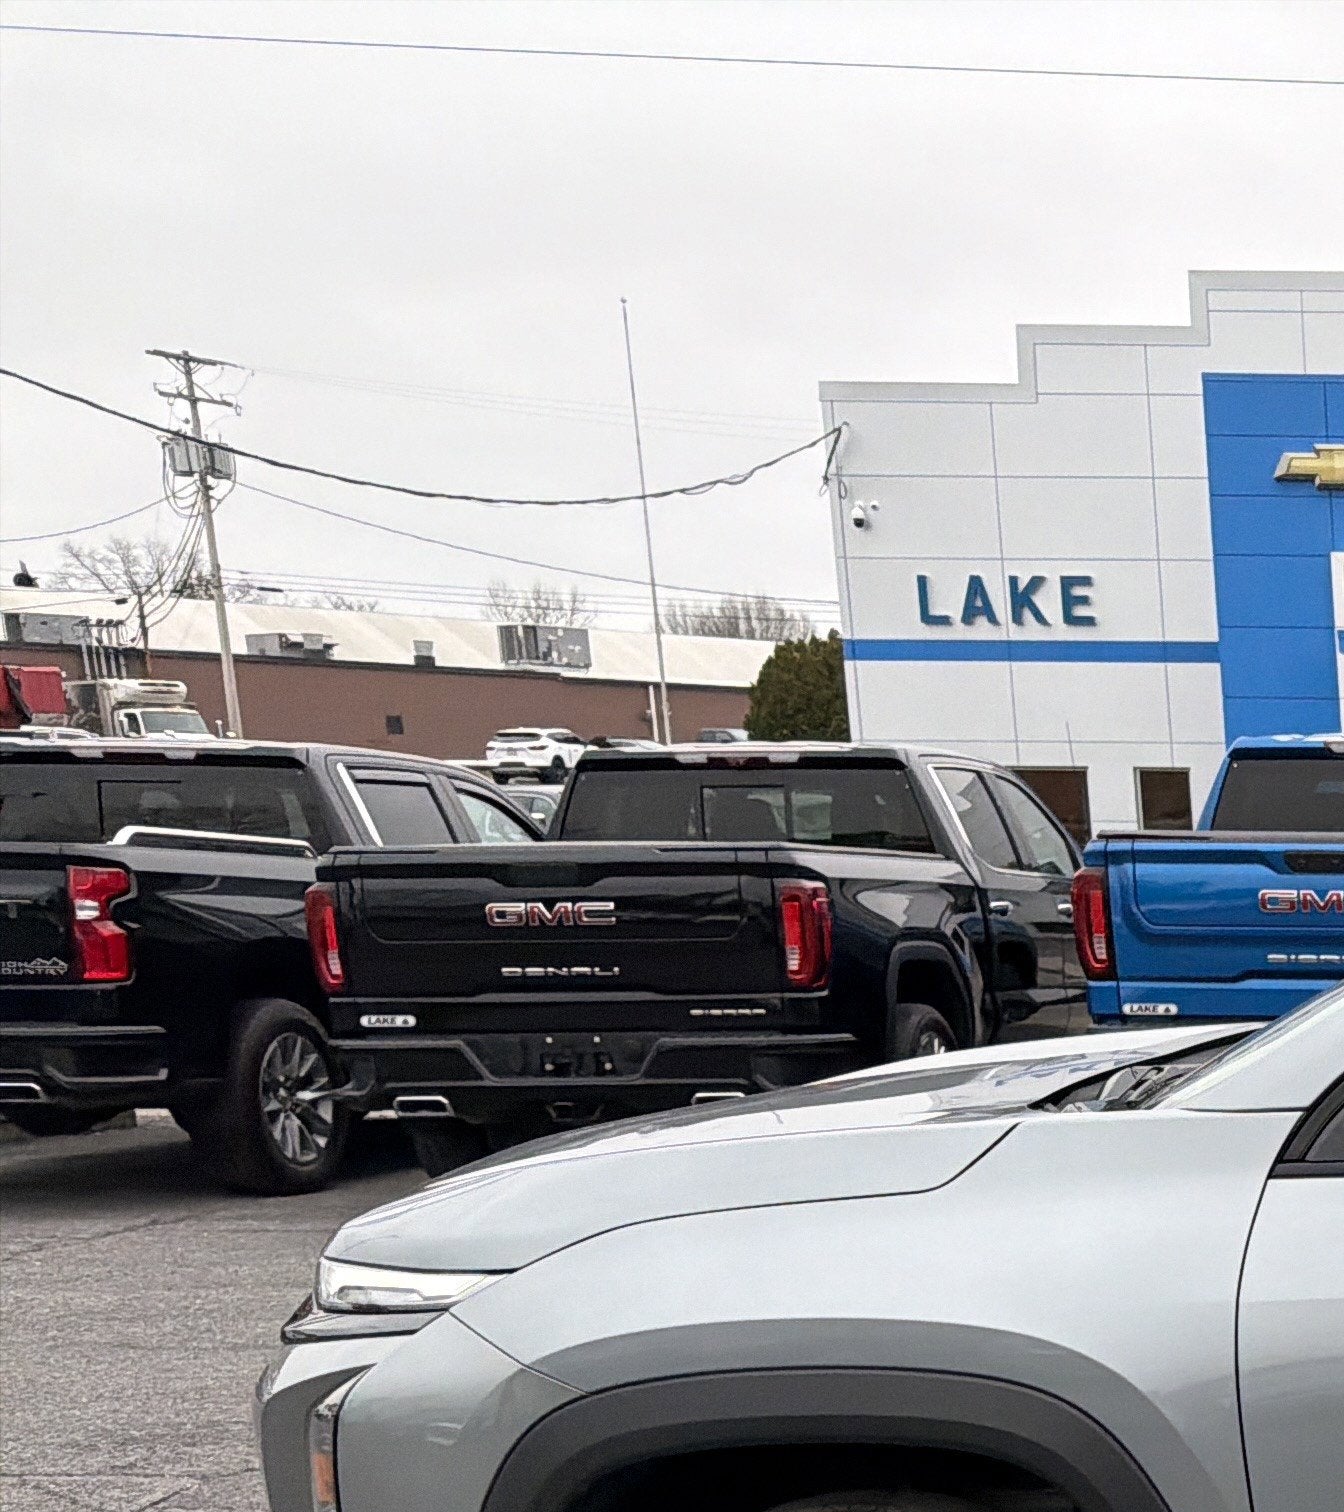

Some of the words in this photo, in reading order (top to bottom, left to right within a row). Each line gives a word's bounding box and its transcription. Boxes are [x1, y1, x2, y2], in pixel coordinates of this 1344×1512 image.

[916, 574, 1097, 626] LAKE
[484, 901, 617, 928] GMC
[501, 966, 621, 977] DENALI
[1129, 1004, 1159, 1013] LAKE
[367, 1016, 397, 1025] LAKE
